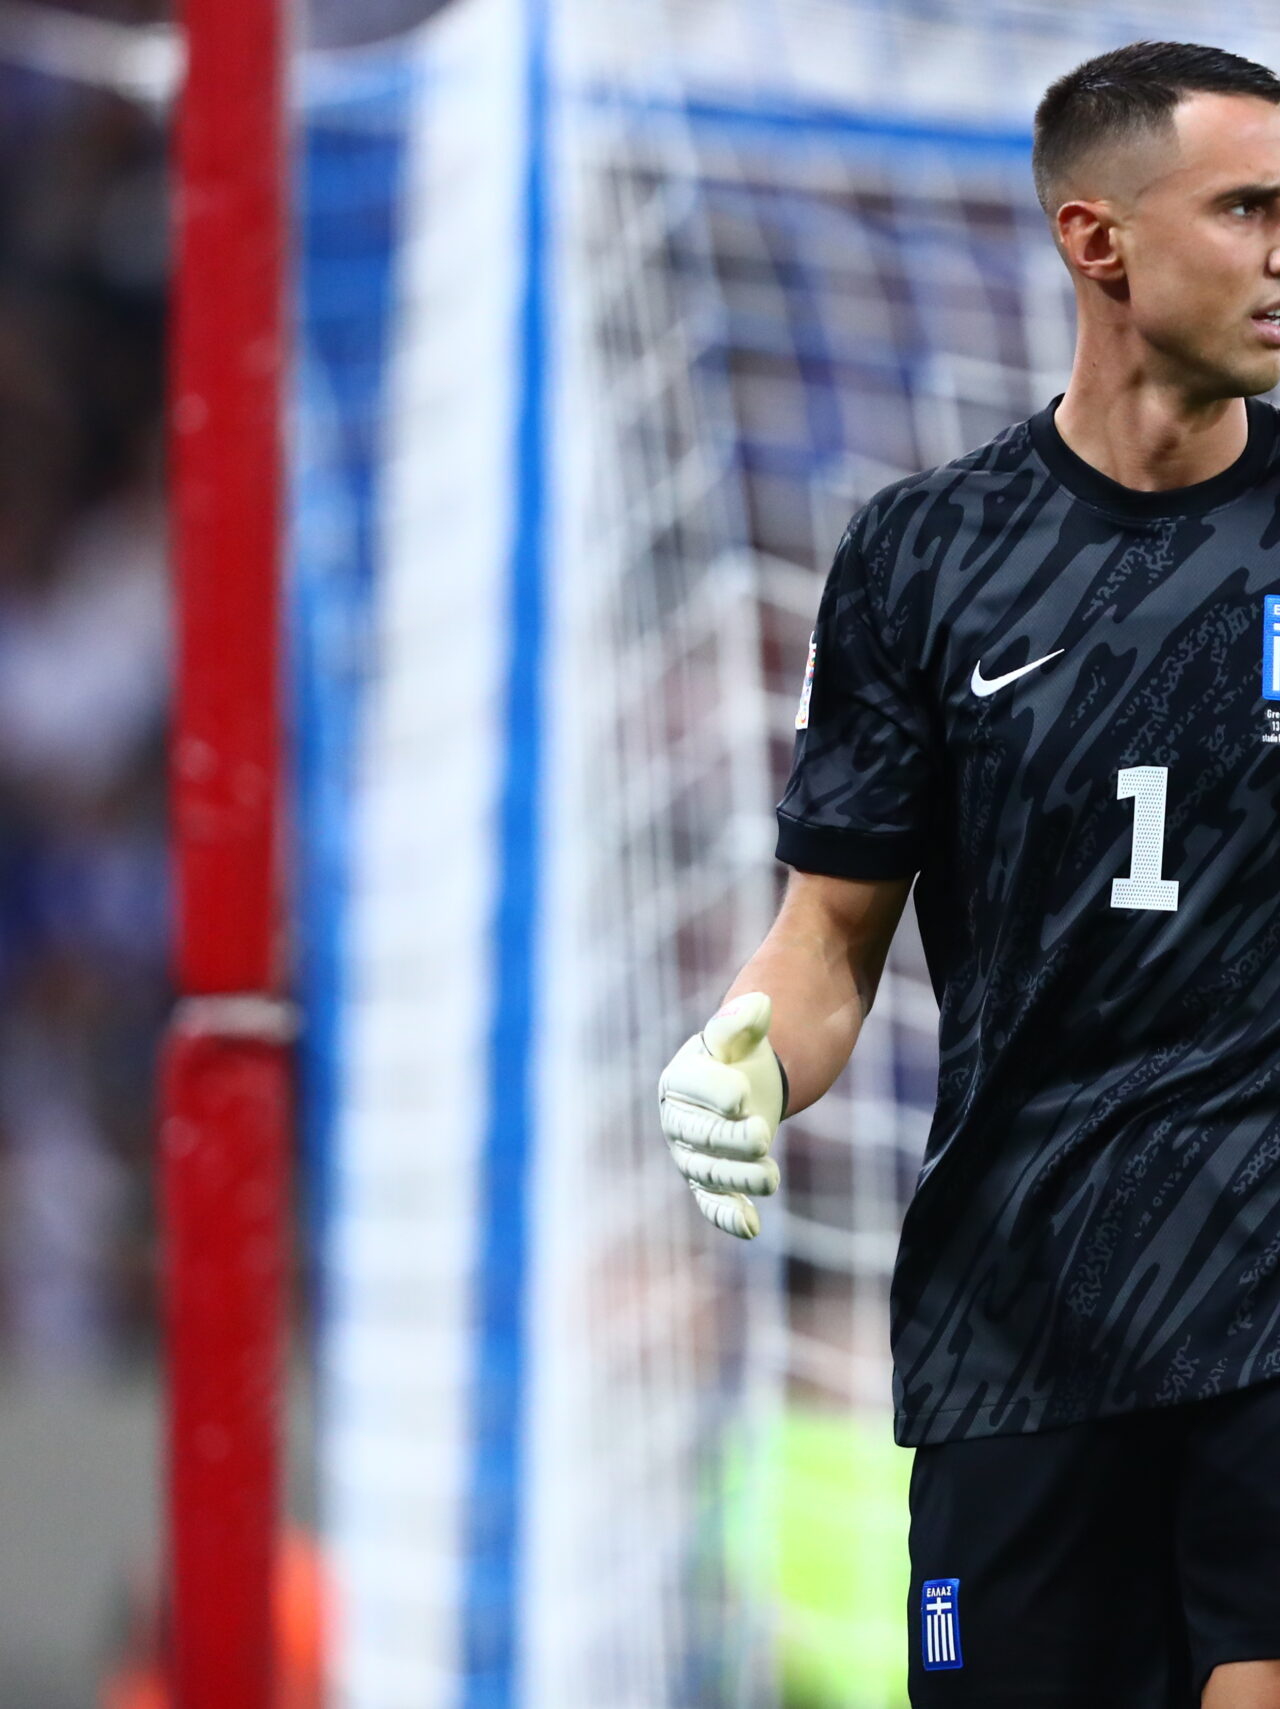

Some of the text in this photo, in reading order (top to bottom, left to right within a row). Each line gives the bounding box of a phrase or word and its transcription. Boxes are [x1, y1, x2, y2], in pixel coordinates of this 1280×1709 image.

[1272, 720, 1280, 731] 13
[1110, 765, 1180, 911] 1
[926, 1585, 952, 1598] ΕΛΛΑΣ
